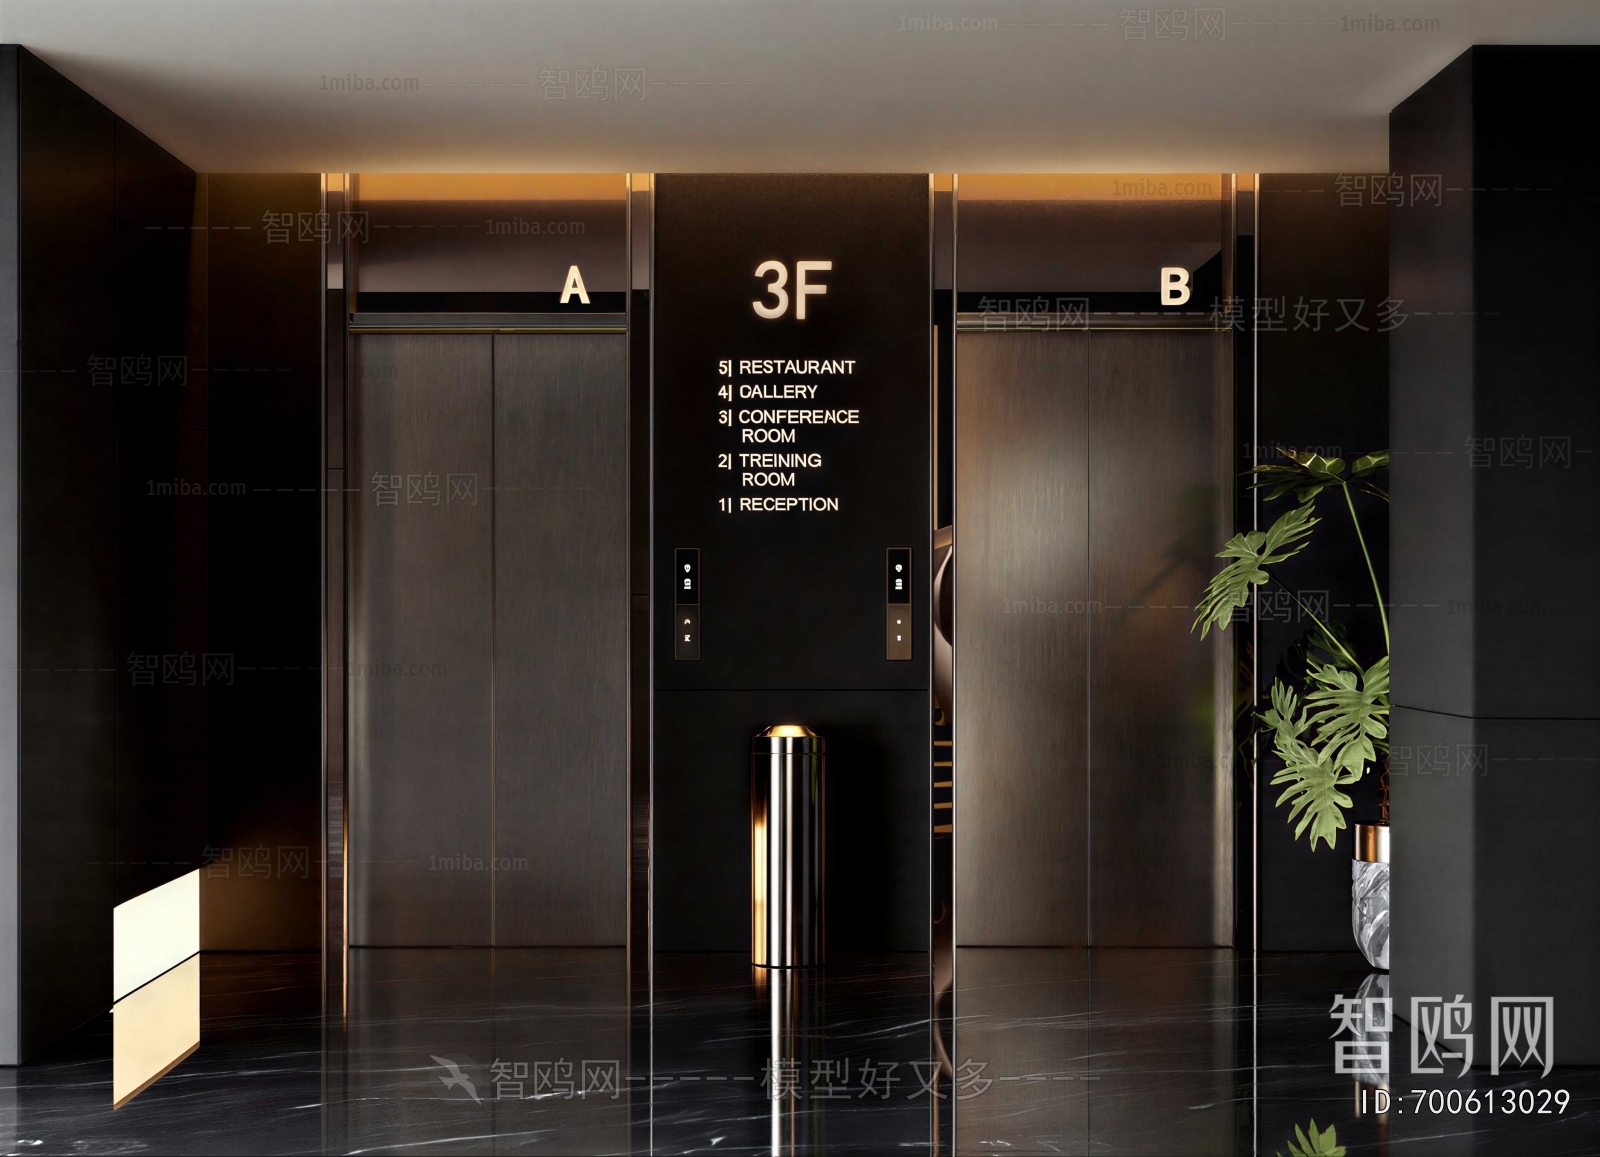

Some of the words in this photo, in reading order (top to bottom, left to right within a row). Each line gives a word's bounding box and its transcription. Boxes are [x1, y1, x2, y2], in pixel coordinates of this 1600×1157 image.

[559, 265, 591, 305] A
[752, 260, 833, 320] 3F
[1160, 267, 1192, 306] B
[739, 360, 856, 374] RESTAURANT
[738, 409, 859, 424] CONFERENCE
[742, 428, 796, 443] ROOM
[739, 453, 822, 468] TREINING
[742, 472, 796, 487] ROOM
[740, 497, 839, 511] RECEPTION
